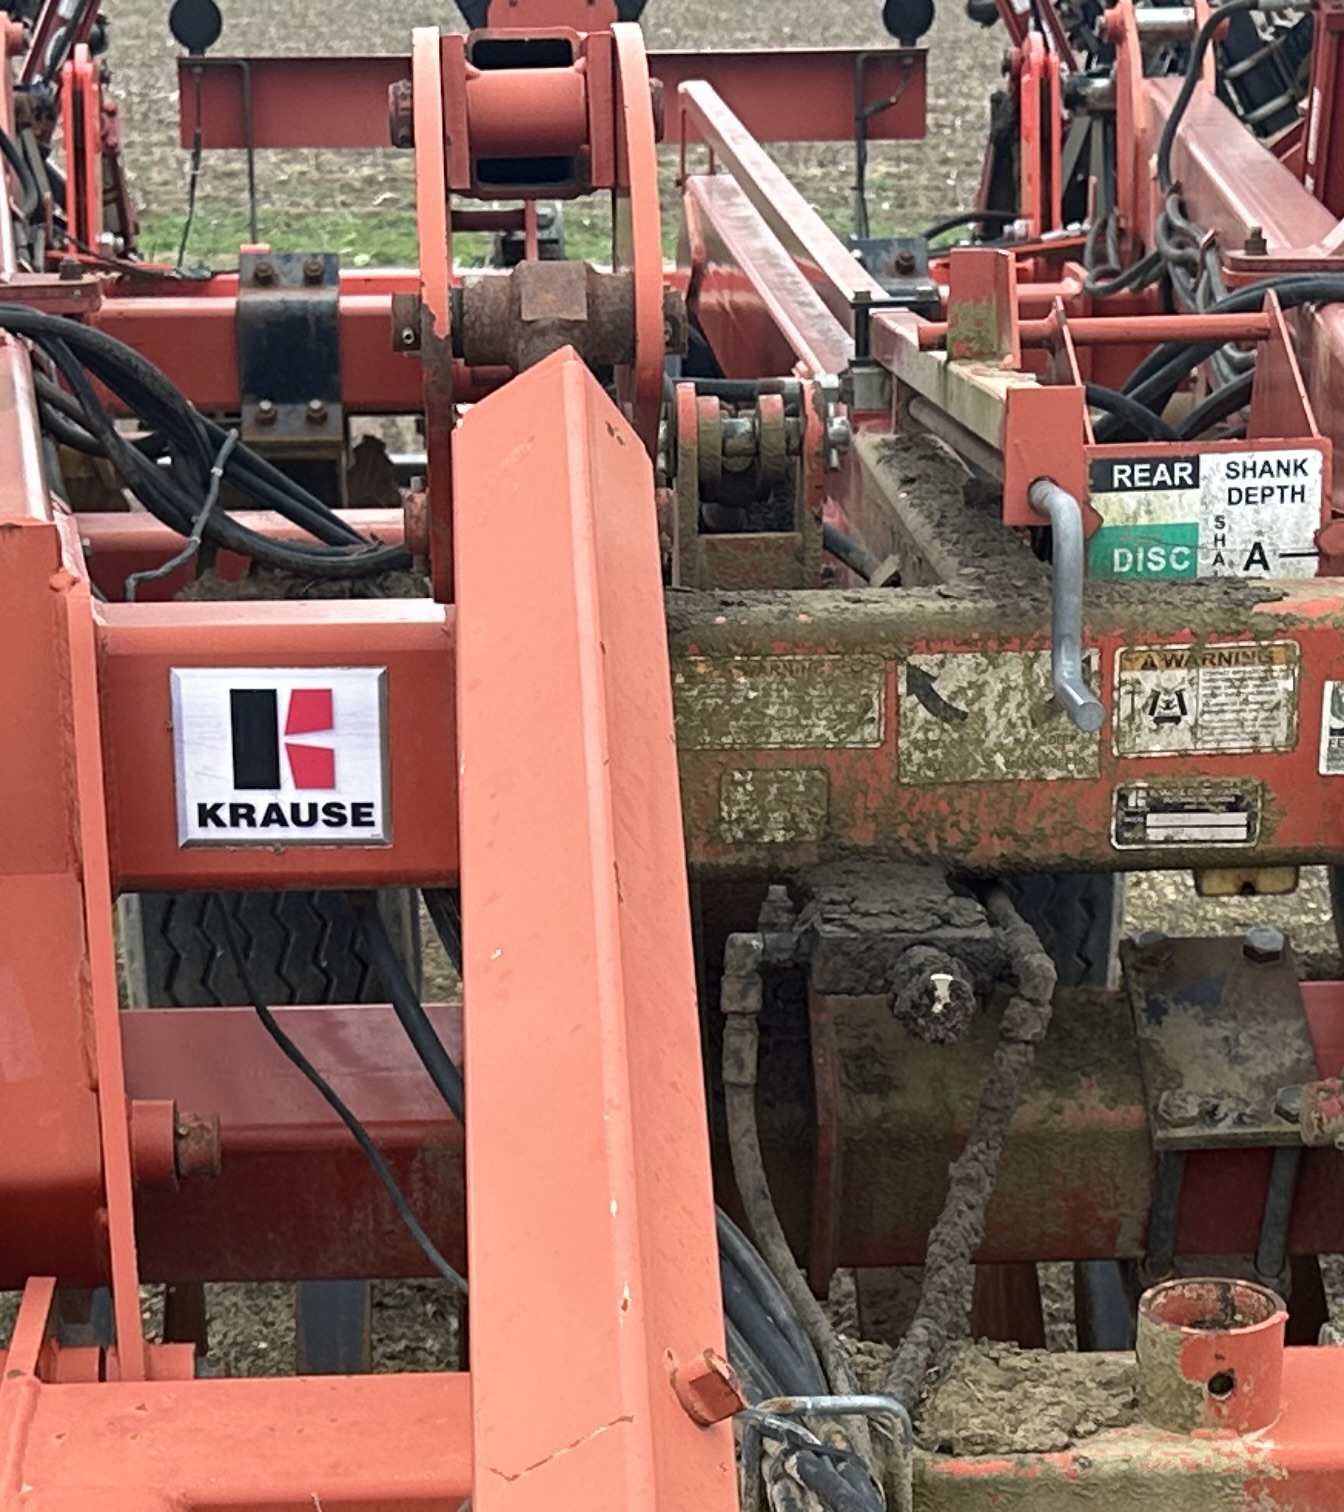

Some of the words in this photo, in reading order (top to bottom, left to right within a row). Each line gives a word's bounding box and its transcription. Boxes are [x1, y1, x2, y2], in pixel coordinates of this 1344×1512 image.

[1112, 462, 1194, 488] REAR
[1225, 457, 1309, 480] SHANK
[1227, 484, 1306, 506] DEPTH
[1113, 546, 1191, 573] DISC
[1242, 541, 1271, 571] A
[197, 801, 376, 829] KRAUSE
